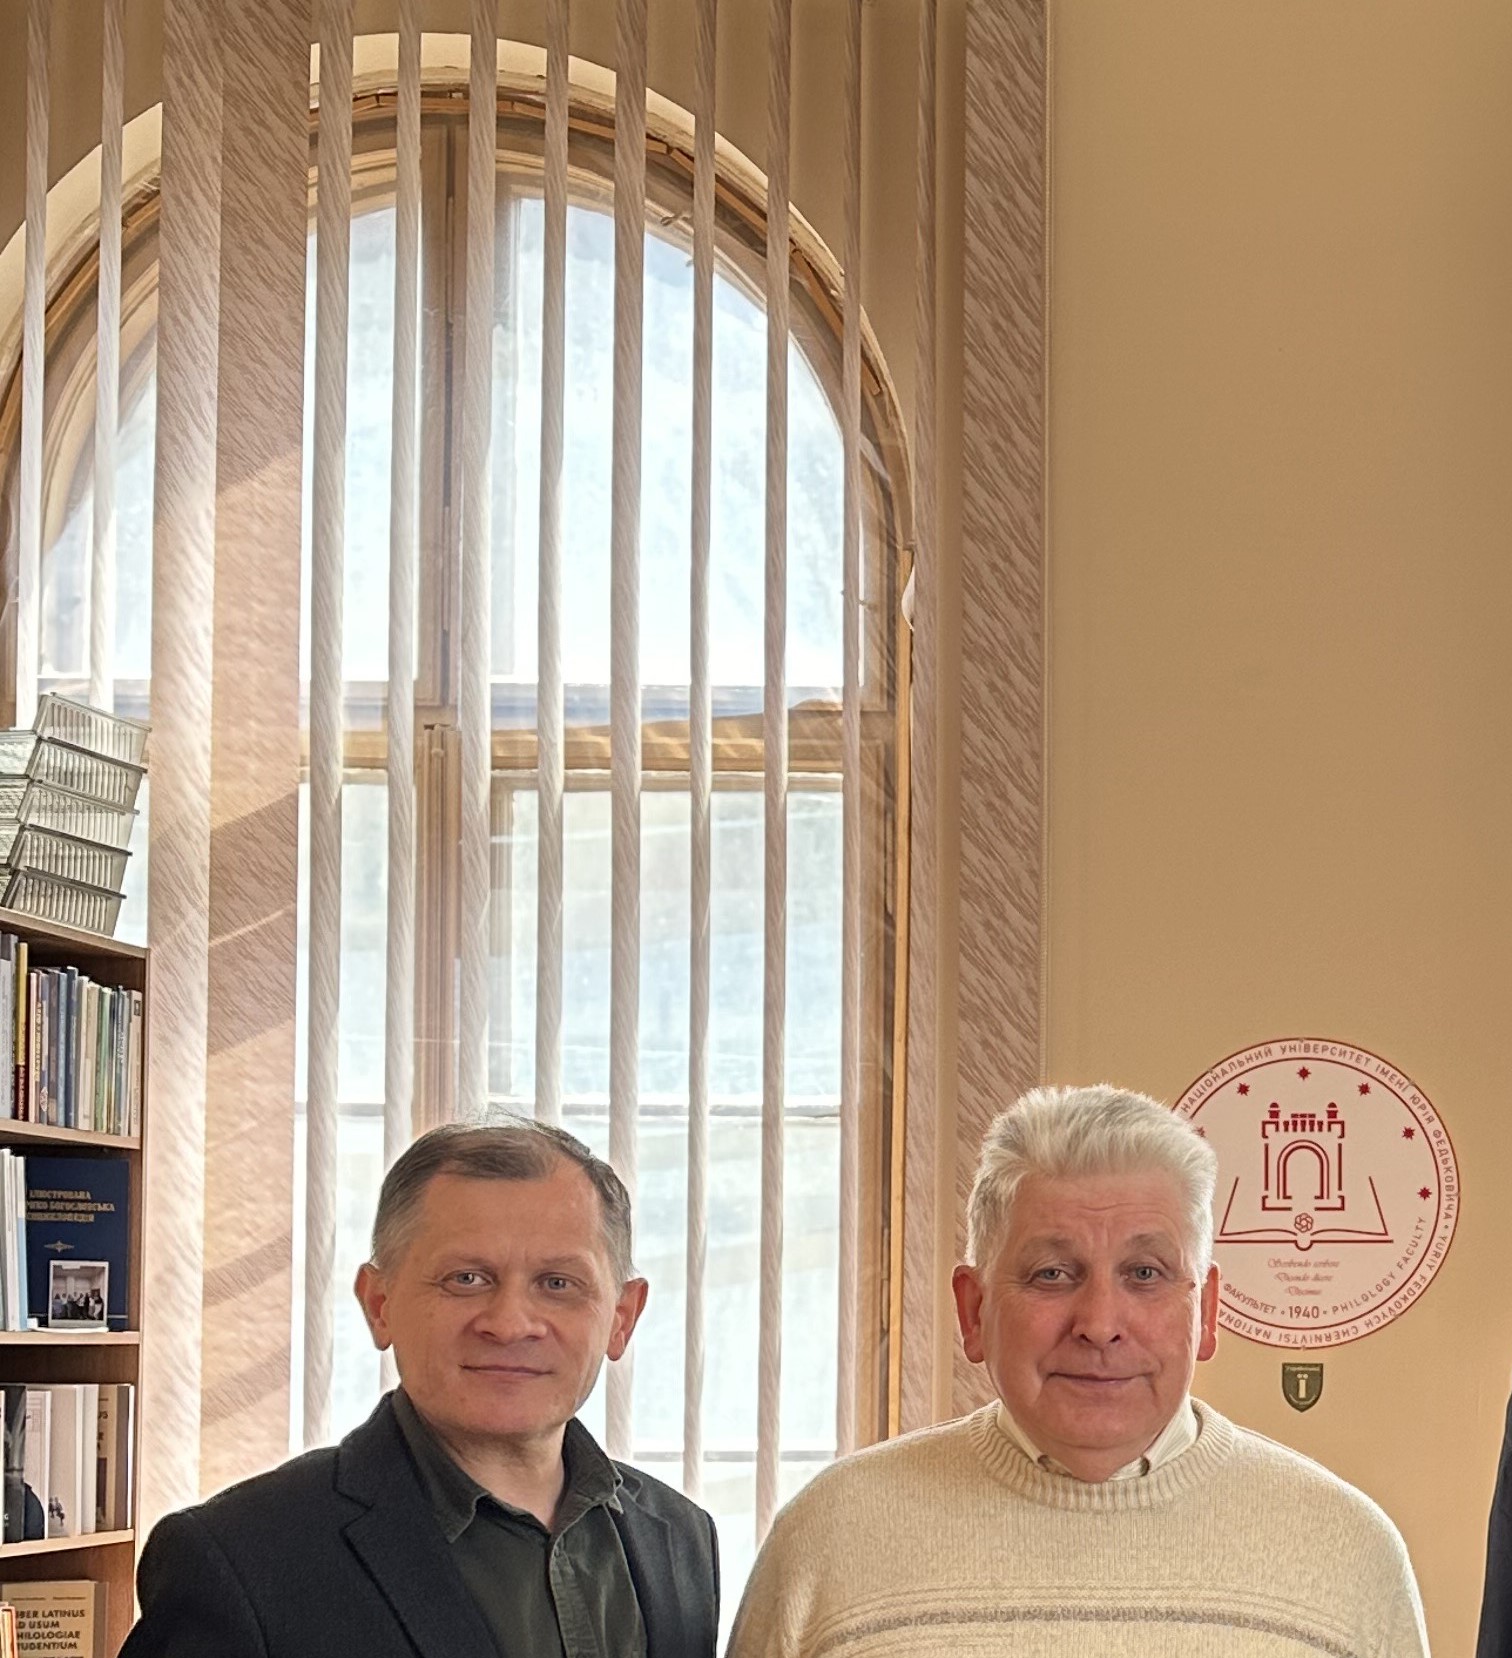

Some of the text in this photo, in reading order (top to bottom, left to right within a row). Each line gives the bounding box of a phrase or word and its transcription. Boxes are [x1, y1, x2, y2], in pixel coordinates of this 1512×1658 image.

[1180, 1043, 1455, 1220] НАЦІОНАЛЬНИЙ УНІВЕРСИТЕТ ІМЕНІ ЮРІЯ ФЕДЬКОВИЧА
[1331, 1216, 1427, 1315] PHILOLOGY FACULTY
[1218, 1235, 1448, 1345] YURIY FEDKOVYCH CHERNIVTSI NATIONA
[1223, 1283, 1277, 1315] ФАКУЛЬТЕТ
[1288, 1305, 1320, 1319] 1940
[15, 1609, 86, 1619] IBER LATINUS
[28, 1620, 60, 1629] USUM
[17, 1630, 81, 1640] HILOLOGIAE
[17, 1642, 78, 1651] TUDENTIUM
